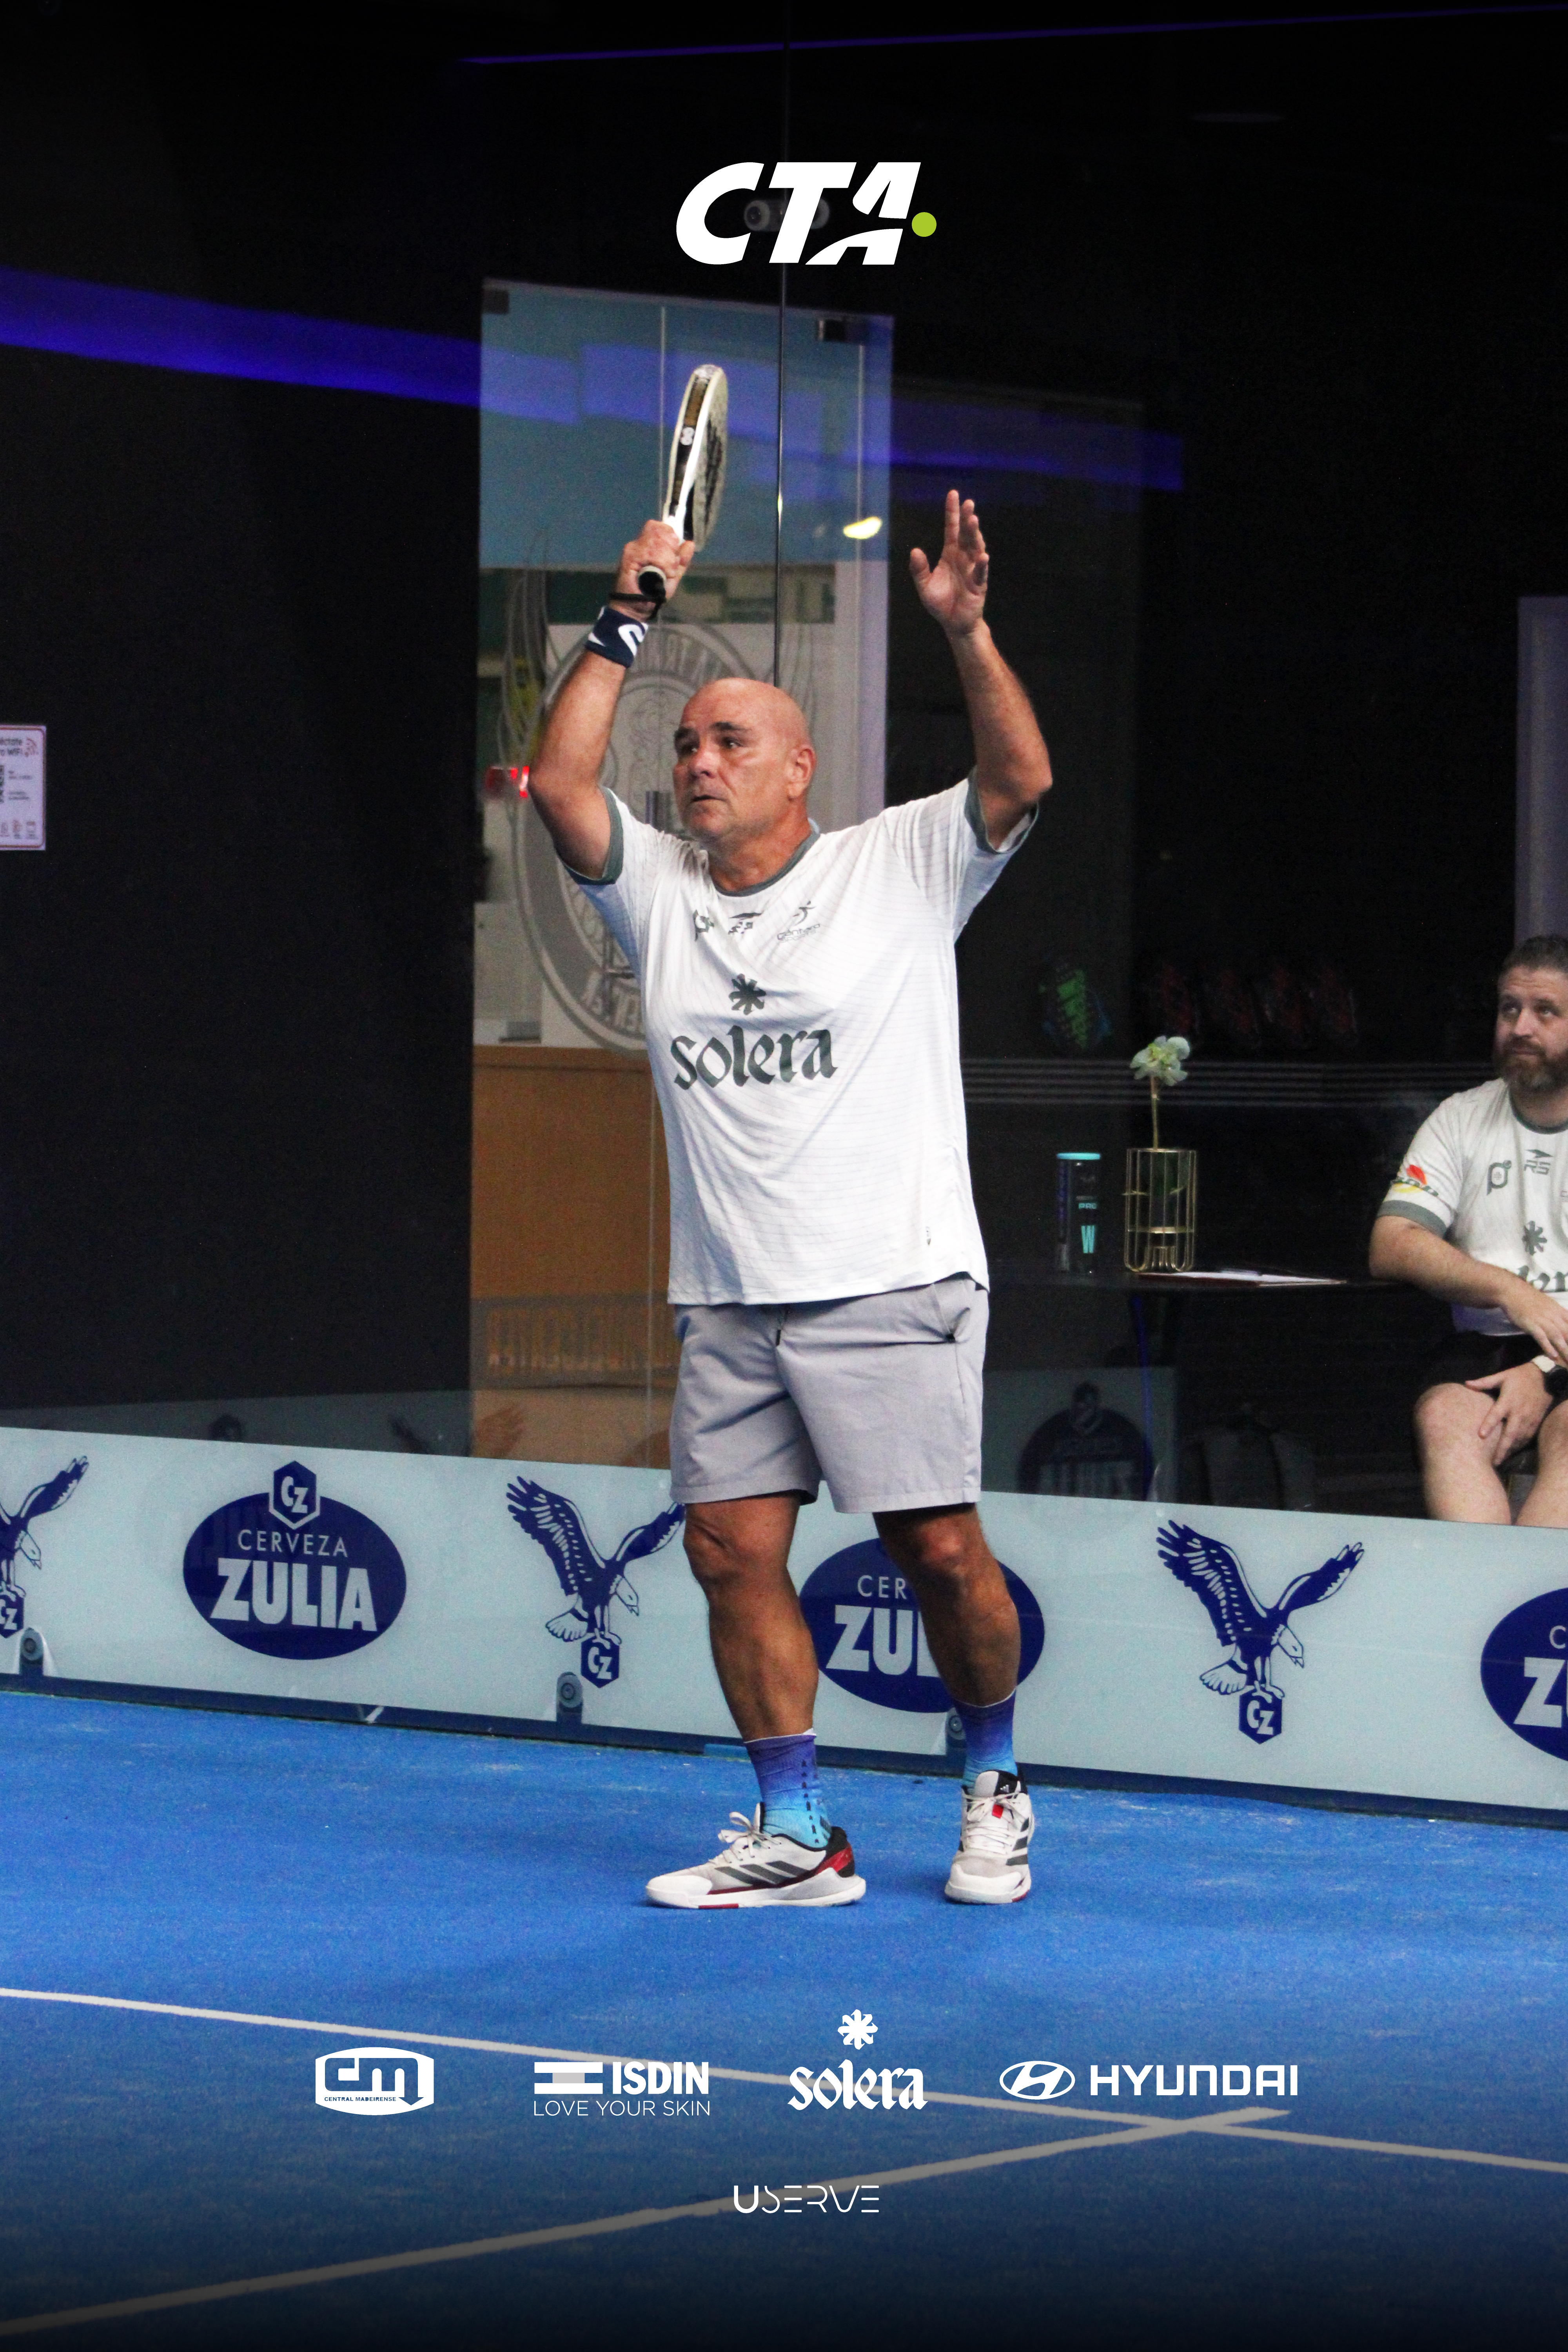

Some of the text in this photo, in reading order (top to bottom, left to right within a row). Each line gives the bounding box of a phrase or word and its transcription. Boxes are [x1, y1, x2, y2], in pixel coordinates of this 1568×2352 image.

[671, 1025, 838, 1090] solera
[281, 1475, 308, 1514] CZ
[238, 1529, 348, 1557] CERVEZA
[210, 1557, 377, 1632] ZULIA
[826, 1604, 944, 1679] ZUL
[588, 1647, 612, 1680] CZ
[1246, 1699, 1275, 1735] CZ
